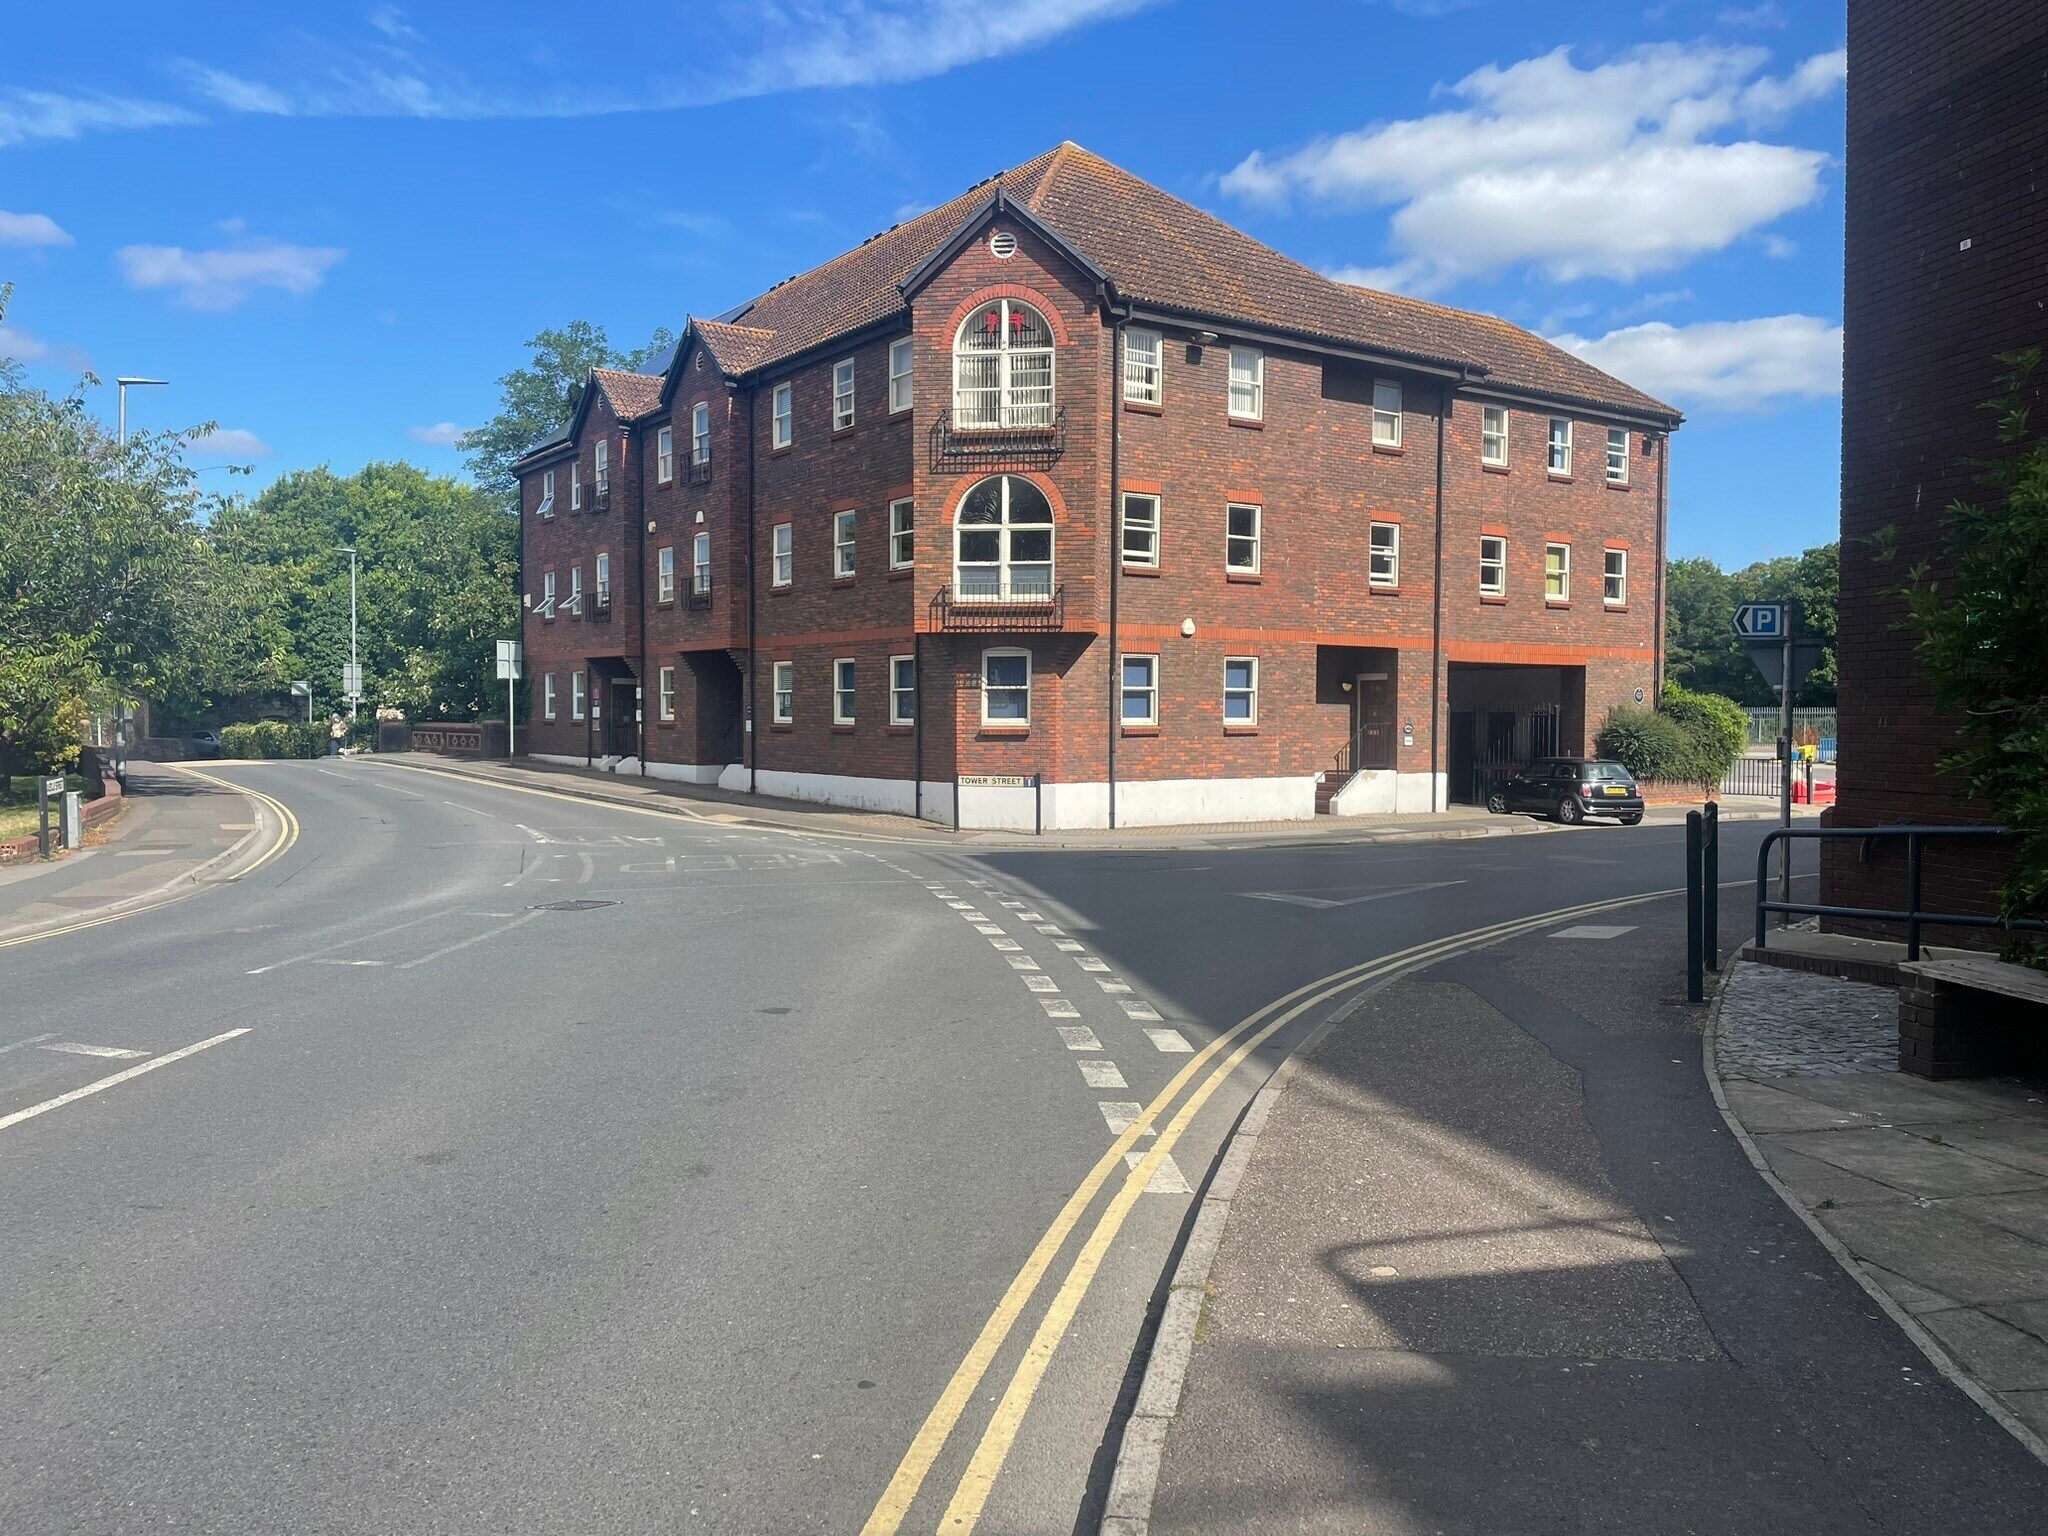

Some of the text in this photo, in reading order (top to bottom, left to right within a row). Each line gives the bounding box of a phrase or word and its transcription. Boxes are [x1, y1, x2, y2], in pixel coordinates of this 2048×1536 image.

[1757, 610, 1772, 630] P
[961, 777, 1021, 785] TOWER STREET
[619, 853, 849, 873] KEEP
